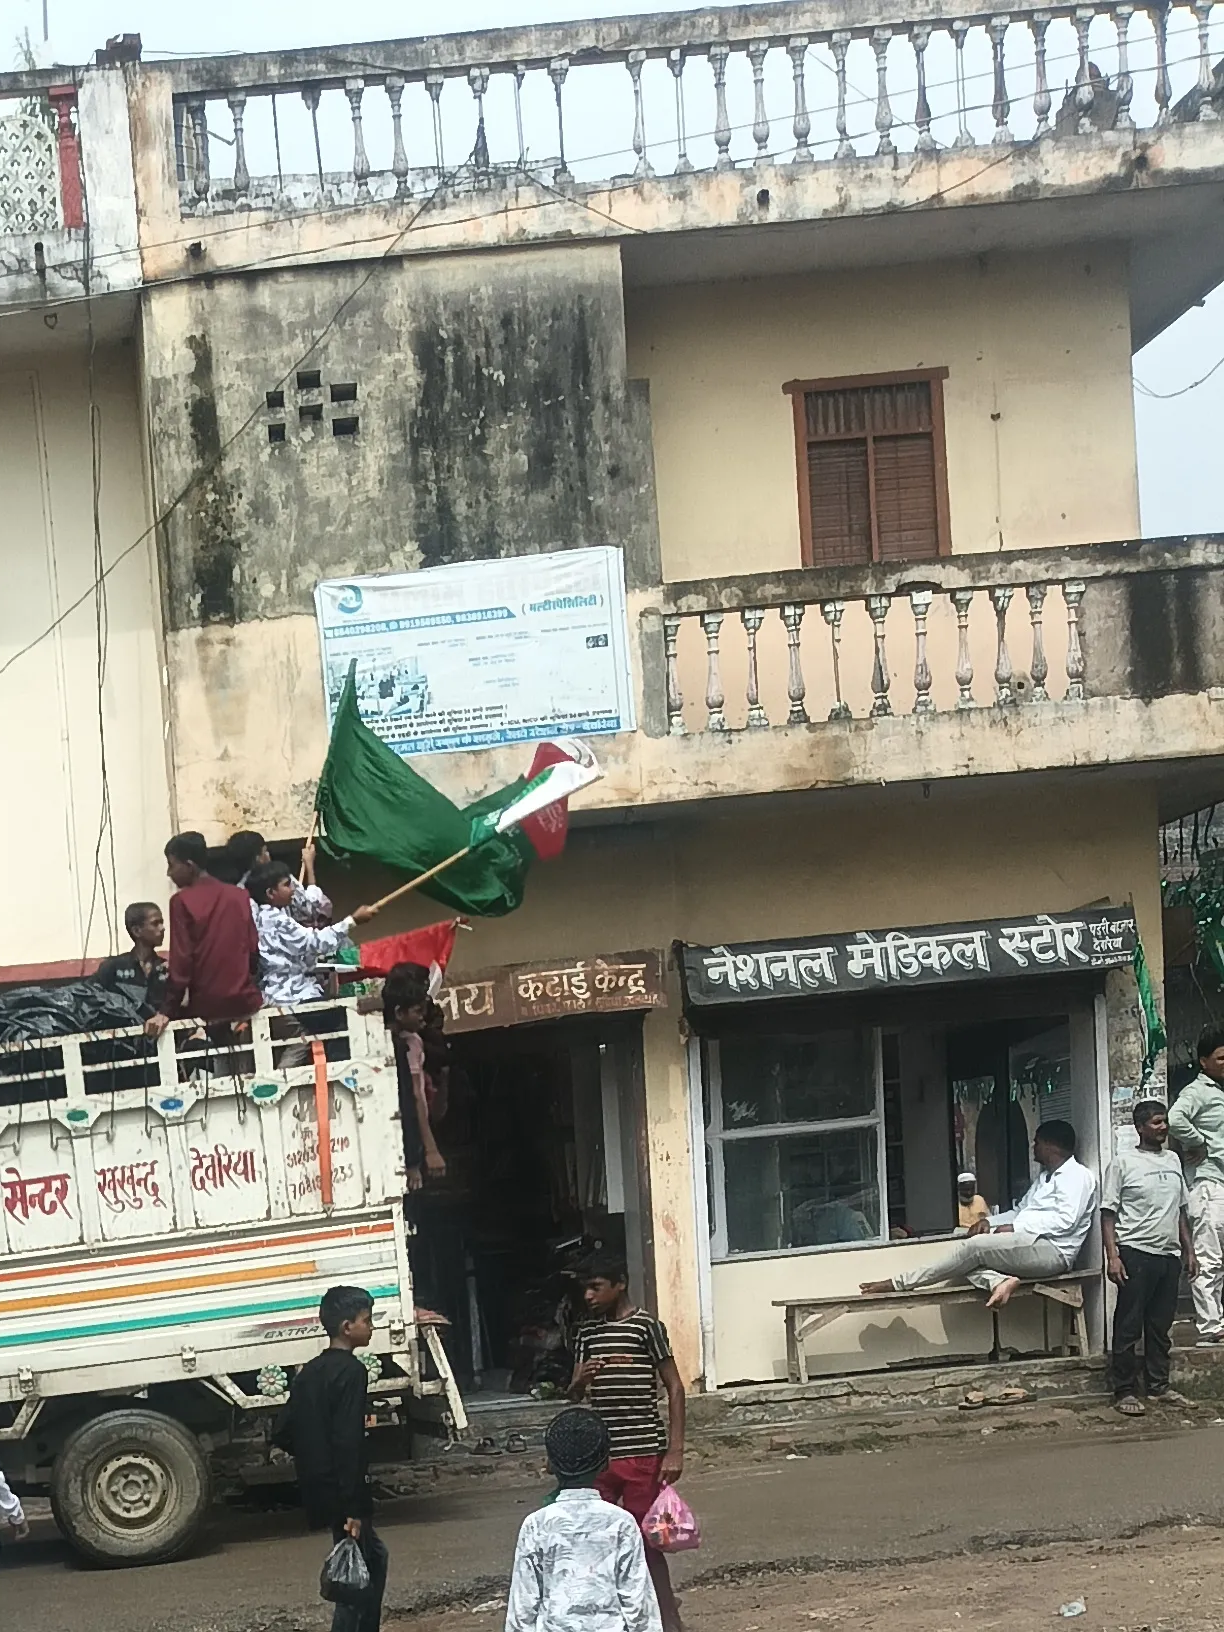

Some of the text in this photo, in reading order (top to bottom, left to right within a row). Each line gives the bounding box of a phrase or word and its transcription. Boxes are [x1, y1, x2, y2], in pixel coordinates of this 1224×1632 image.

[517, 960, 591, 1001] कटाई
[594, 958, 647, 994] केन्द्र
[703, 915, 1089, 992] नेशनल मेडिकल स्टोर
[1, 1167, 73, 1225] सेन्टर
[189, 1143, 257, 1196] देवरिया
